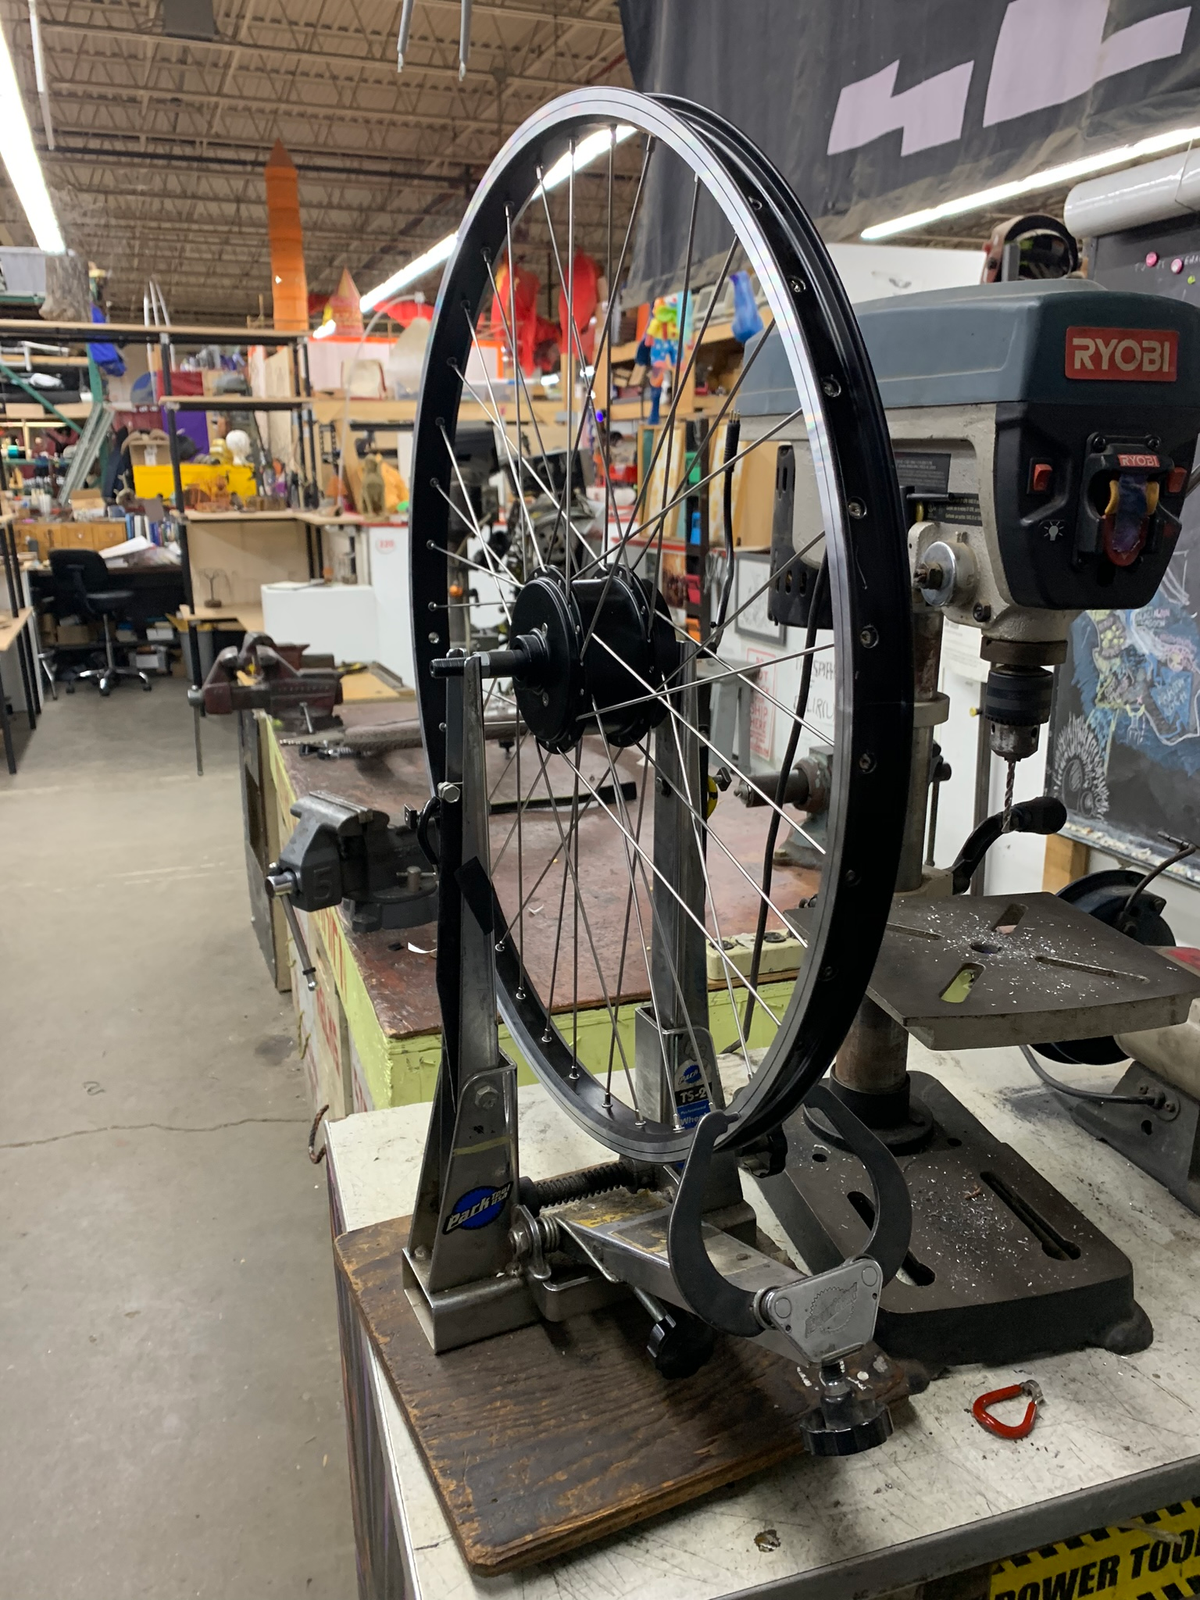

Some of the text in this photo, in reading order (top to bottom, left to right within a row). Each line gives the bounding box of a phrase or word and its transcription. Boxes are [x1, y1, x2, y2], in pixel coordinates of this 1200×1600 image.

[1072, 338, 1171, 373] RYOBI
[1119, 454, 1158, 467] RYOBI
[680, 1087, 706, 1103] TS-2
[446, 1196, 490, 1232] Park
[994, 1554, 1121, 1600] OWER
